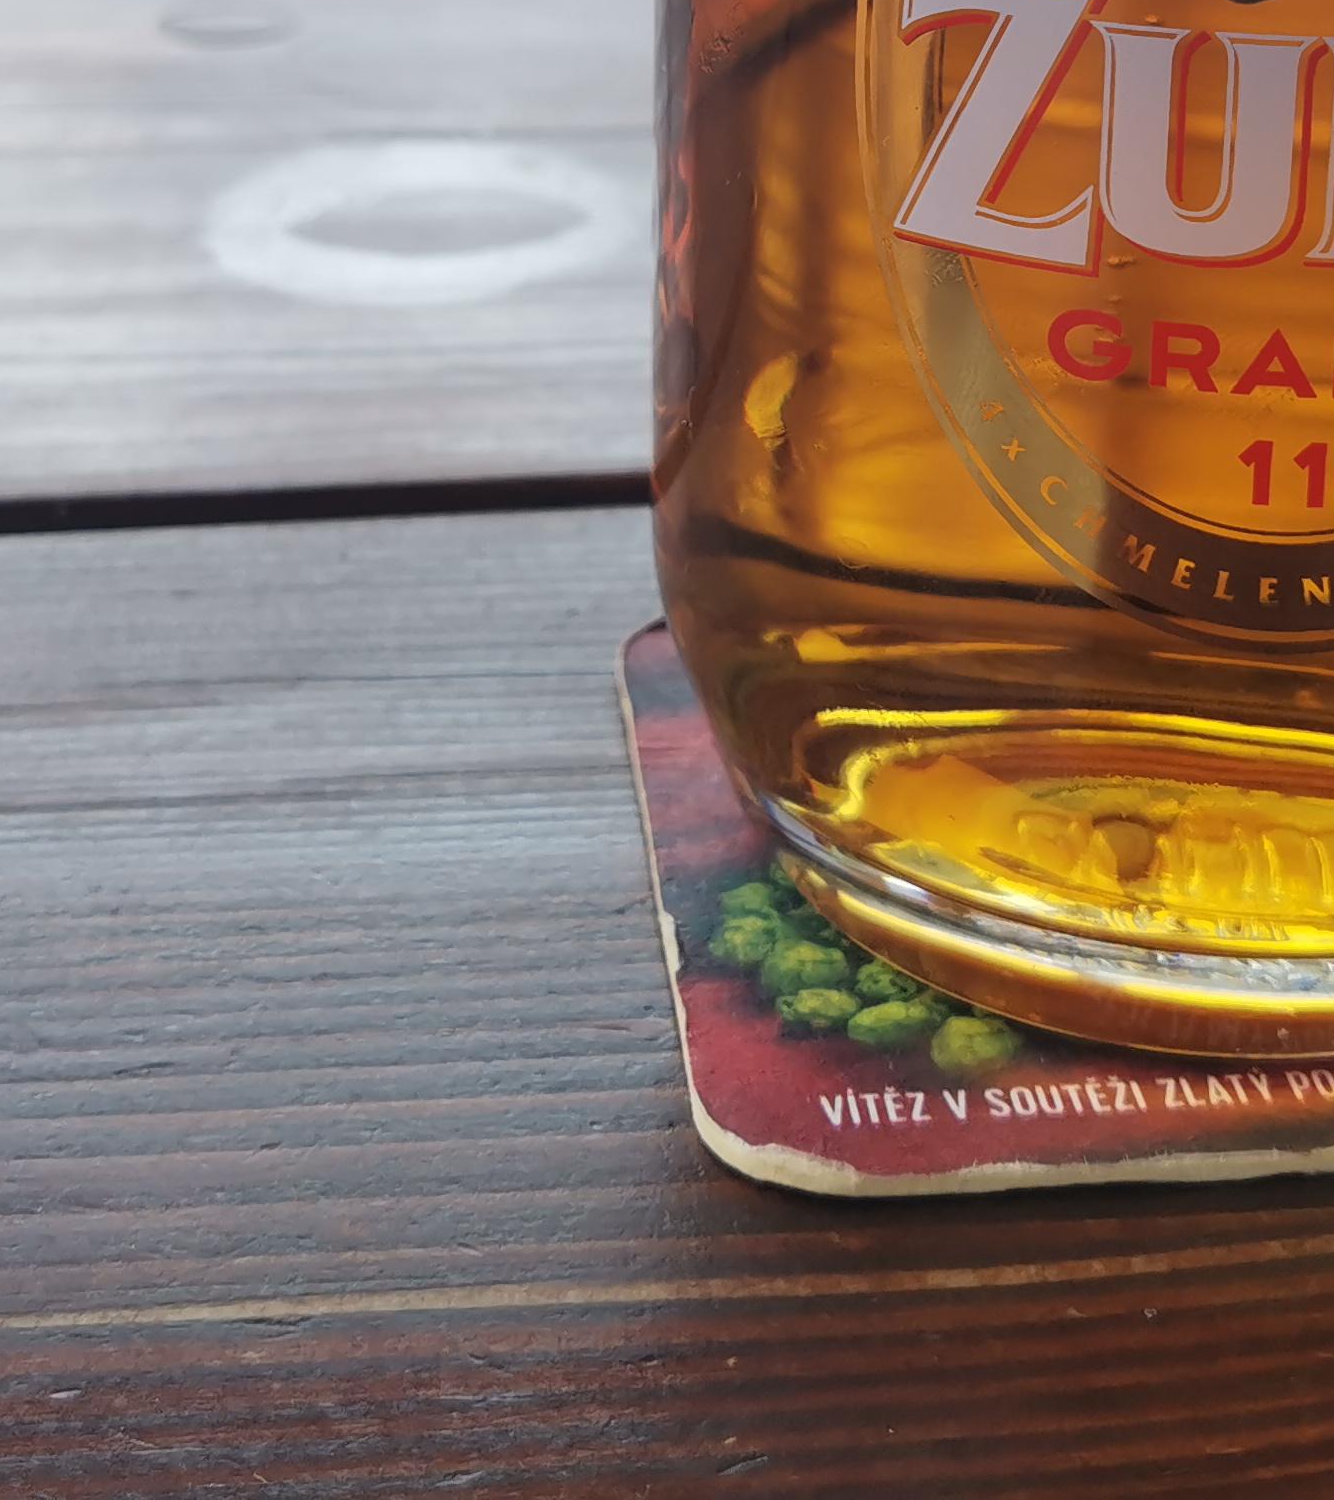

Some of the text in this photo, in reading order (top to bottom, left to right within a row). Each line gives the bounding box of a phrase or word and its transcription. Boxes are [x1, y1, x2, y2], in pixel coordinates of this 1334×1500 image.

[1238, 440, 1329, 508] 11
[821, 1086, 931, 1128] VÍTĚZ
[943, 1088, 968, 1122] V
[985, 1075, 1147, 1118] SOUTĚŽI
[1155, 1067, 1275, 1110] ZLATÝ
